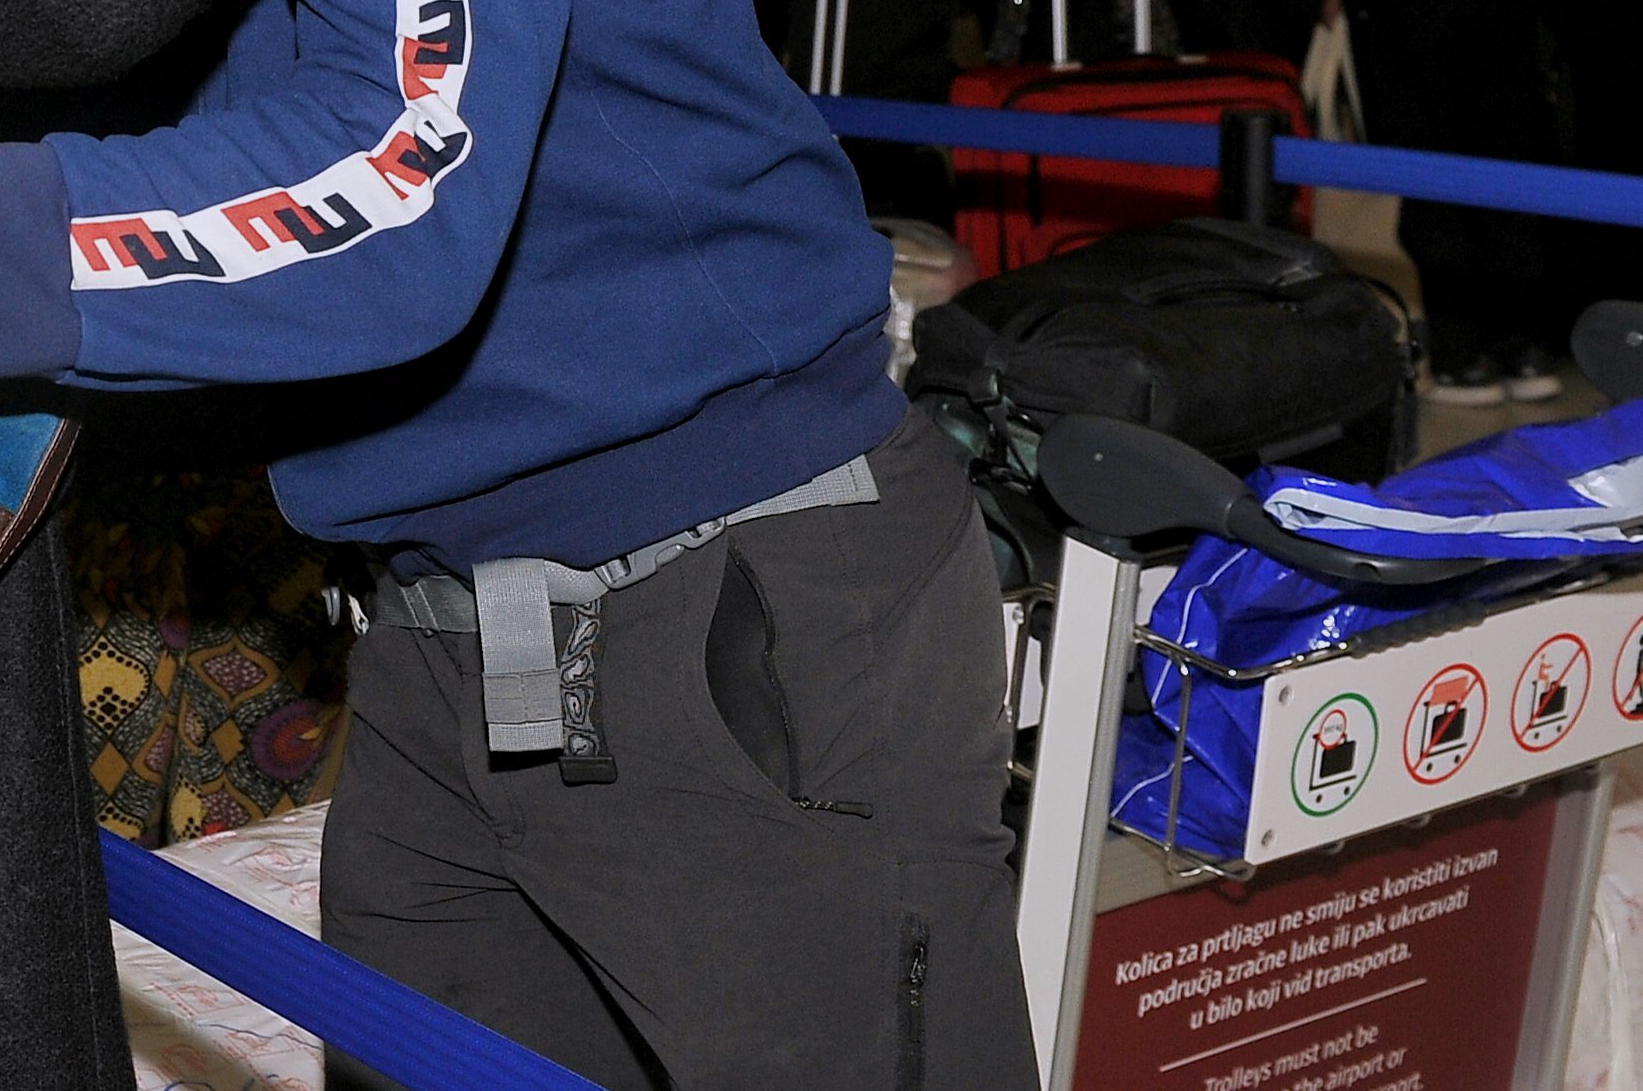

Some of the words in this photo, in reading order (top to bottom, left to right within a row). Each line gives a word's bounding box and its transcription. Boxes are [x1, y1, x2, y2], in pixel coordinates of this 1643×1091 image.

[1115, 951, 1174, 986] Kolica
[1176, 943, 1199, 966] za
[1202, 918, 1276, 962] prtljagu
[1278, 910, 1303, 933] ne
[1305, 890, 1357, 925] smiju
[1358, 885, 1381, 908] se
[1381, 856, 1453, 901] koristiti
[1451, 848, 1499, 878] izvan
[1137, 966, 1223, 1019] područja
[1225, 950, 1287, 985] zračne
[1289, 934, 1331, 964] luke
[1331, 924, 1351, 950] ili
[1351, 912, 1386, 949] pak
[1387, 885, 1470, 931] ukrcavati
[1189, 1011, 1204, 1030] u
[1206, 995, 1243, 1025] bilo
[1244, 979, 1282, 1012] koji
[1283, 969, 1312, 999] vid
[1314, 942, 1413, 990] transporta.
[1204, 1061, 1272, 1091] Trolleys
[1274, 1042, 1321, 1077] must
[1321, 1030, 1355, 1059] not
[1356, 1024, 1380, 1049] be
[1325, 1053, 1385, 1090] airport
[1386, 1046, 1408, 1069] or
